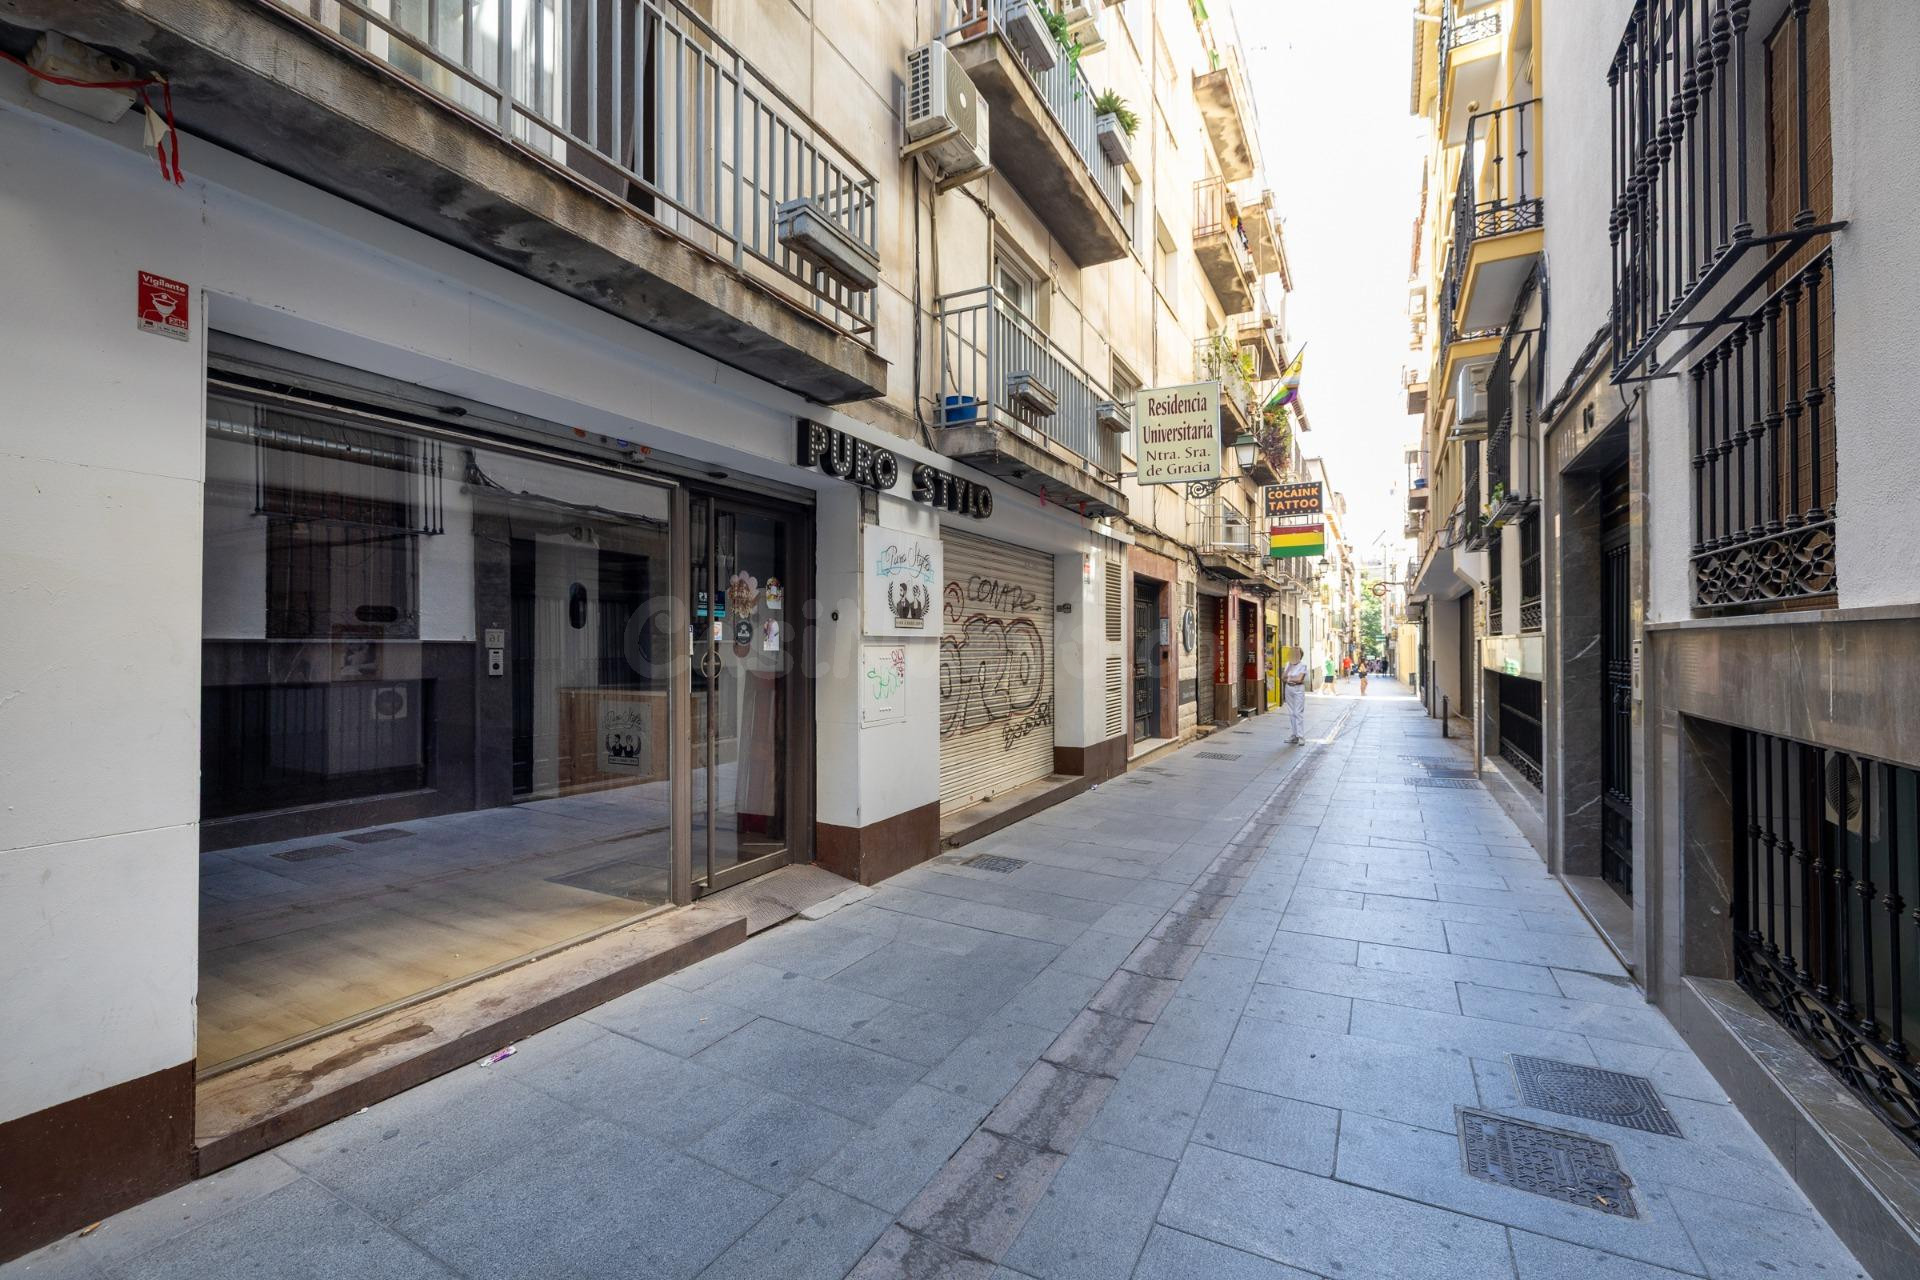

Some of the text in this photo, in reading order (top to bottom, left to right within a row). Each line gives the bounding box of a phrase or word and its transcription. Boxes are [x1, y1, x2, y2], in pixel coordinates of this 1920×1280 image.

[142, 273, 186, 292] Vigilante
[1148, 391, 1208, 417] Residencia
[1143, 419, 1214, 444] Universitaria
[1146, 446, 1211, 462] Ntra. Sra.
[797, 418, 993, 519] PURO STYLO
[1146, 461, 1211, 477] de Gracia
[1268, 486, 1319, 500] COCAINK
[1268, 499, 1319, 511] TATTOO
